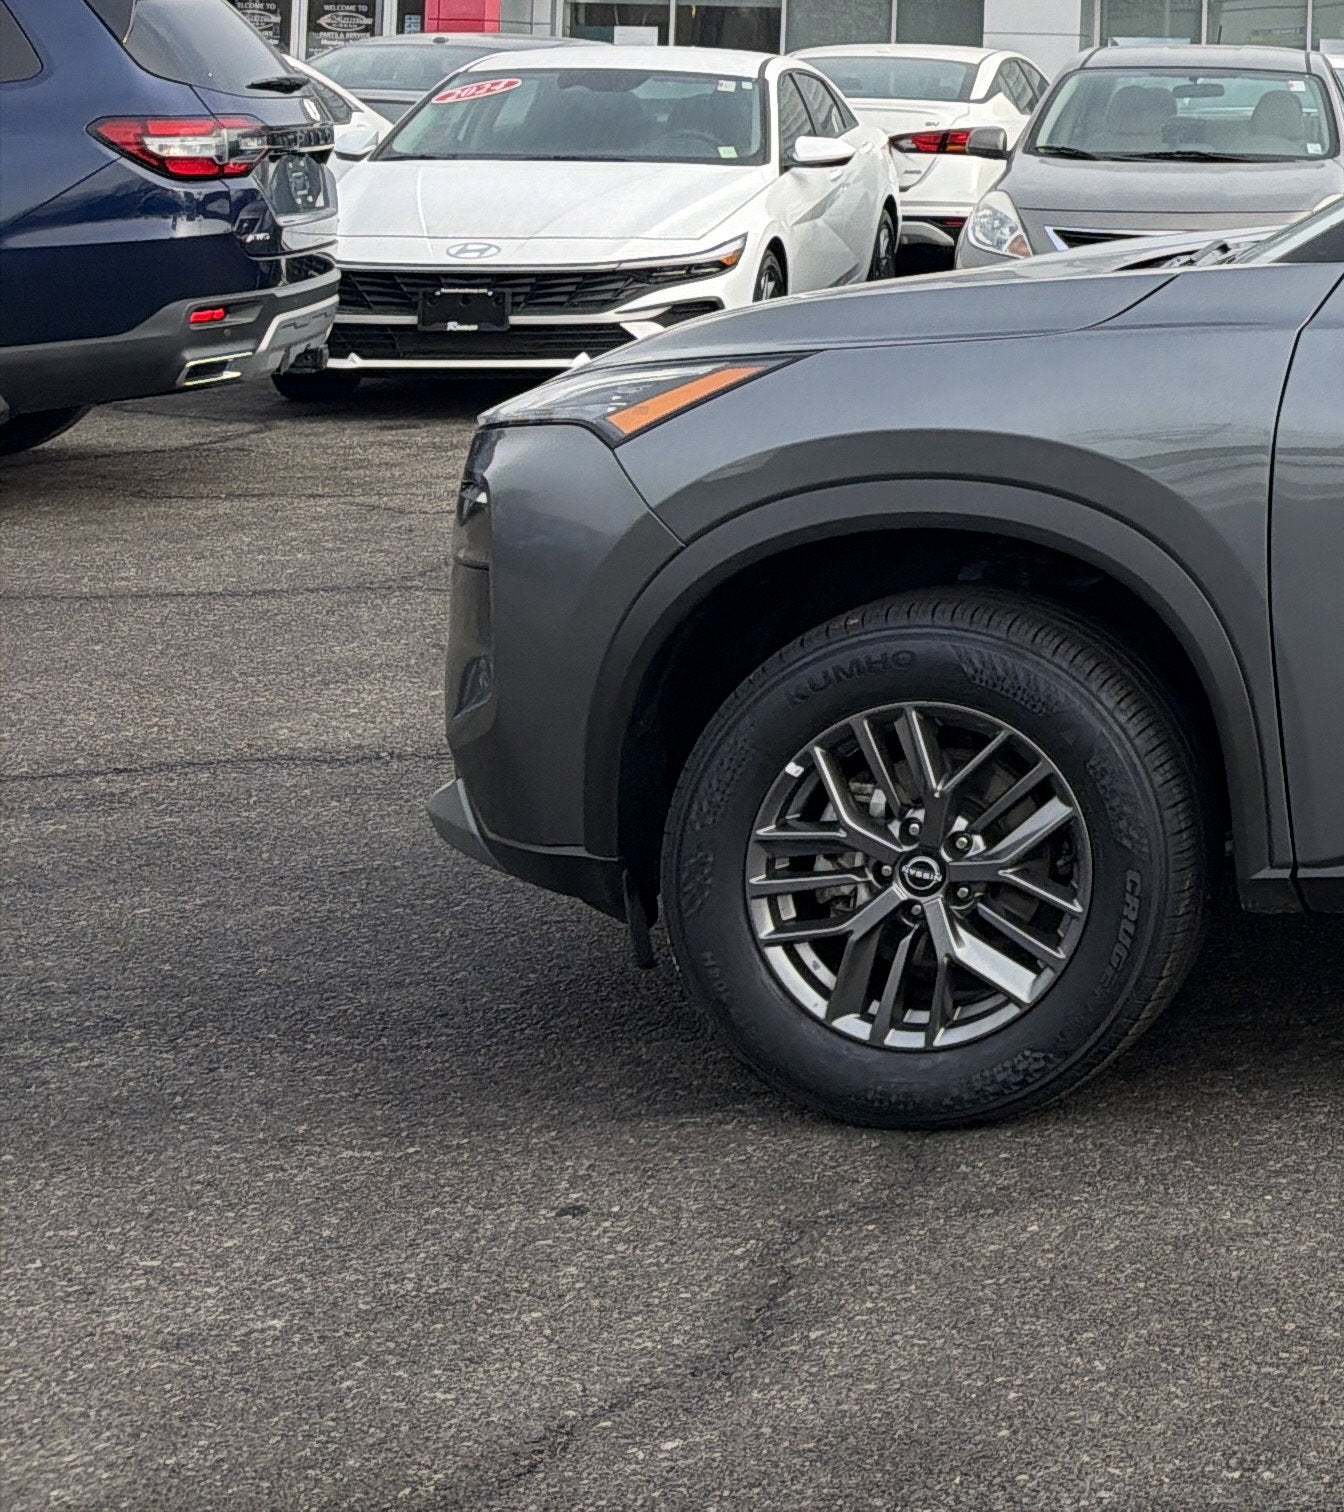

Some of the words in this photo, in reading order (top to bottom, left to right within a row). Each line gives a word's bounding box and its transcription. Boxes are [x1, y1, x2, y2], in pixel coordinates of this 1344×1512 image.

[266, 2, 276, 10] TO
[323, 4, 356, 12] WELCOME
[358, 4, 368, 12] TO
[787, 649, 917, 705] KUMHO
